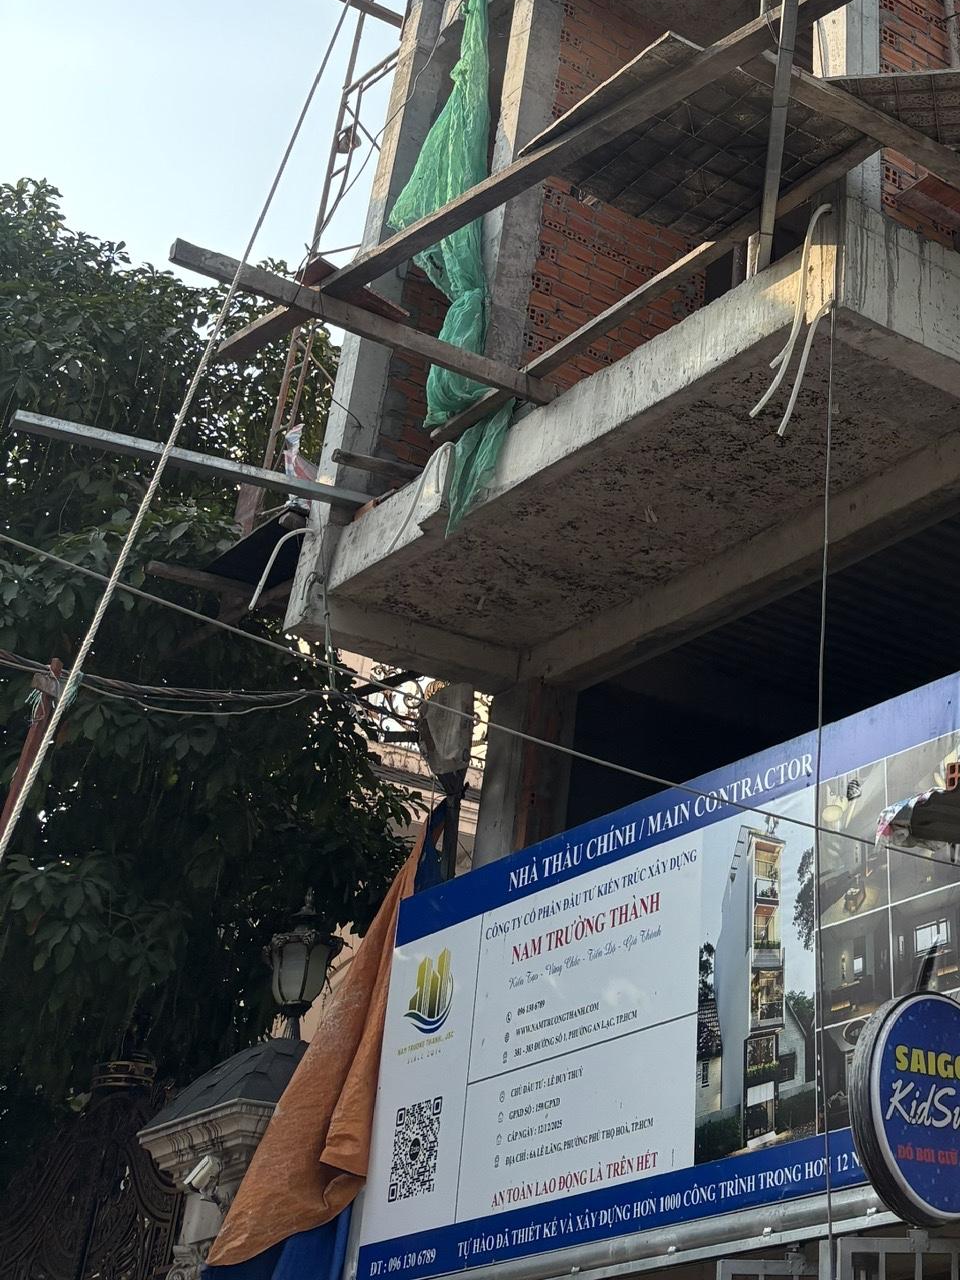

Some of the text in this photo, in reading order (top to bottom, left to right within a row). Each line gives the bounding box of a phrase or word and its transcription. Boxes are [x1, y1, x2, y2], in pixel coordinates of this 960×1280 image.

[508, 754, 813, 892] NHÀ THẦU CHÍNH / MAIN CONTRACTOR
[485, 920, 510, 940] CÔNG
[511, 915, 524, 931] TY
[583, 886, 596, 904] TƯ
[597, 877, 620, 898] KIẾN
[621, 867, 646, 889] TRÚC
[647, 860, 670, 881] XÂY
[669, 848, 698, 877] DỰNG
[511, 891, 661, 965] NAM TRƯỜNG THÀNH
[458, 1237, 473, 1258] TỰ
[472, 1231, 495, 1254] HÀO
[495, 1227, 510, 1249] ĐÃ
[511, 1220, 542, 1245] THIẾT
[542, 1213, 558, 1237] KẾ
[559, 1212, 574, 1234] VÀ
[575, 1208, 600, 1232] XÂY
[599, 1203, 631, 1229] DỰNG
[632, 1196, 657, 1219] HƠN
[659, 1192, 682, 1213] 1000
[683, 1182, 716, 1208] CÔNG
[719, 1173, 756, 1200] TRÌNH
[757, 1166, 802, 1190] TRONG
[804, 1156, 832, 1180] HƠN
[836, 1153, 849, 1173] 12
[491, 1149, 659, 1208] AN TOÀN LAO ĐỘNG LÀ TRÊN HẾT
[369, 1260, 383, 1277] ĐT
[387, 1255, 402, 1272] 096
[403, 1251, 416, 1268] 130
[416, 1248, 437, 1266] 6789
